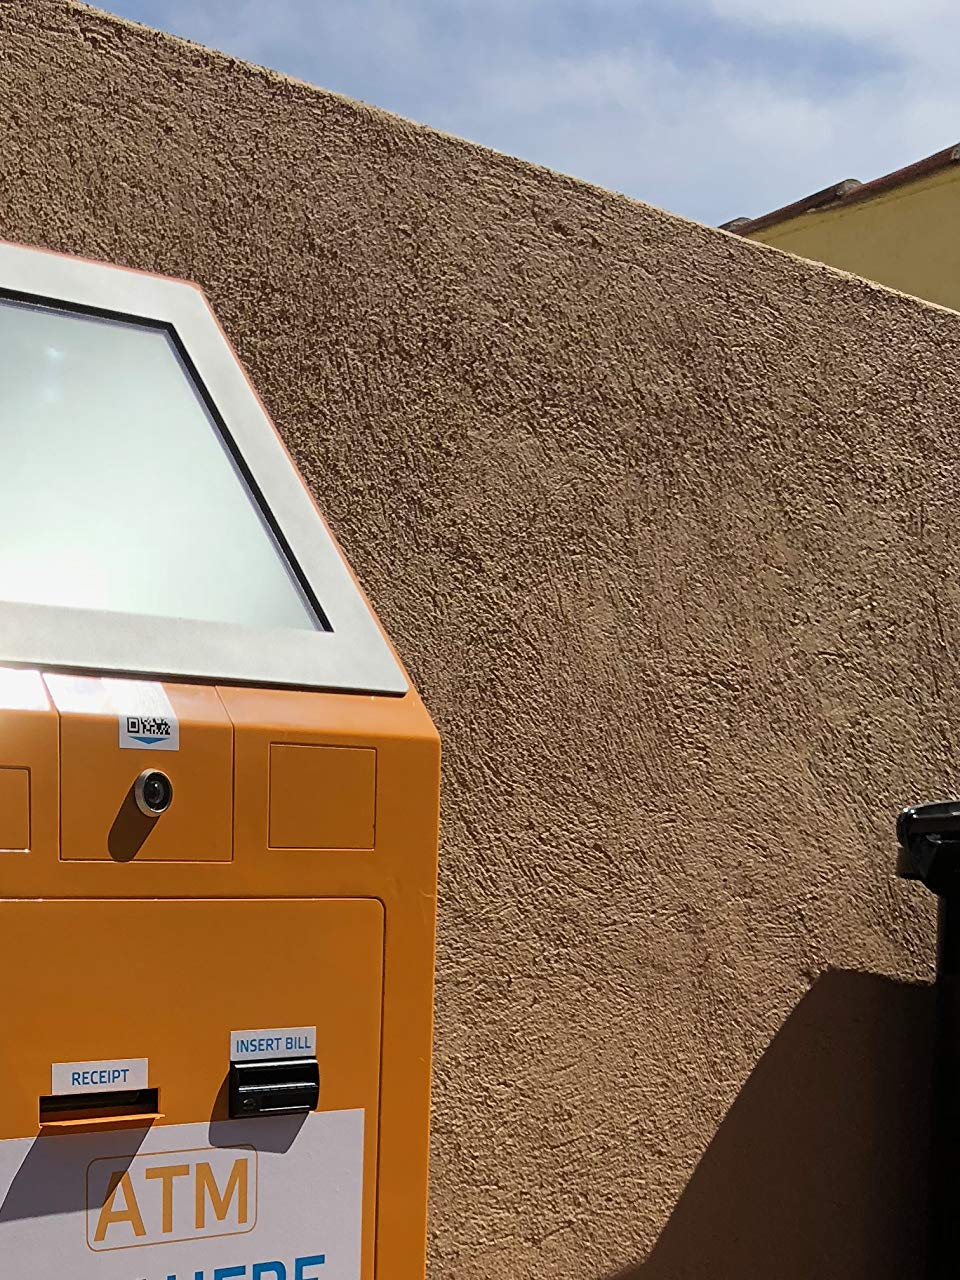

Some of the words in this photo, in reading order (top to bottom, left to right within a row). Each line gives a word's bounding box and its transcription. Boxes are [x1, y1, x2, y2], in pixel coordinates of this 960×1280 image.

[236, 1037, 282, 1053] INSERT
[285, 1036, 311, 1050] BILL
[71, 1069, 129, 1086] RECEIPT
[93, 1158, 248, 1242] ATM
